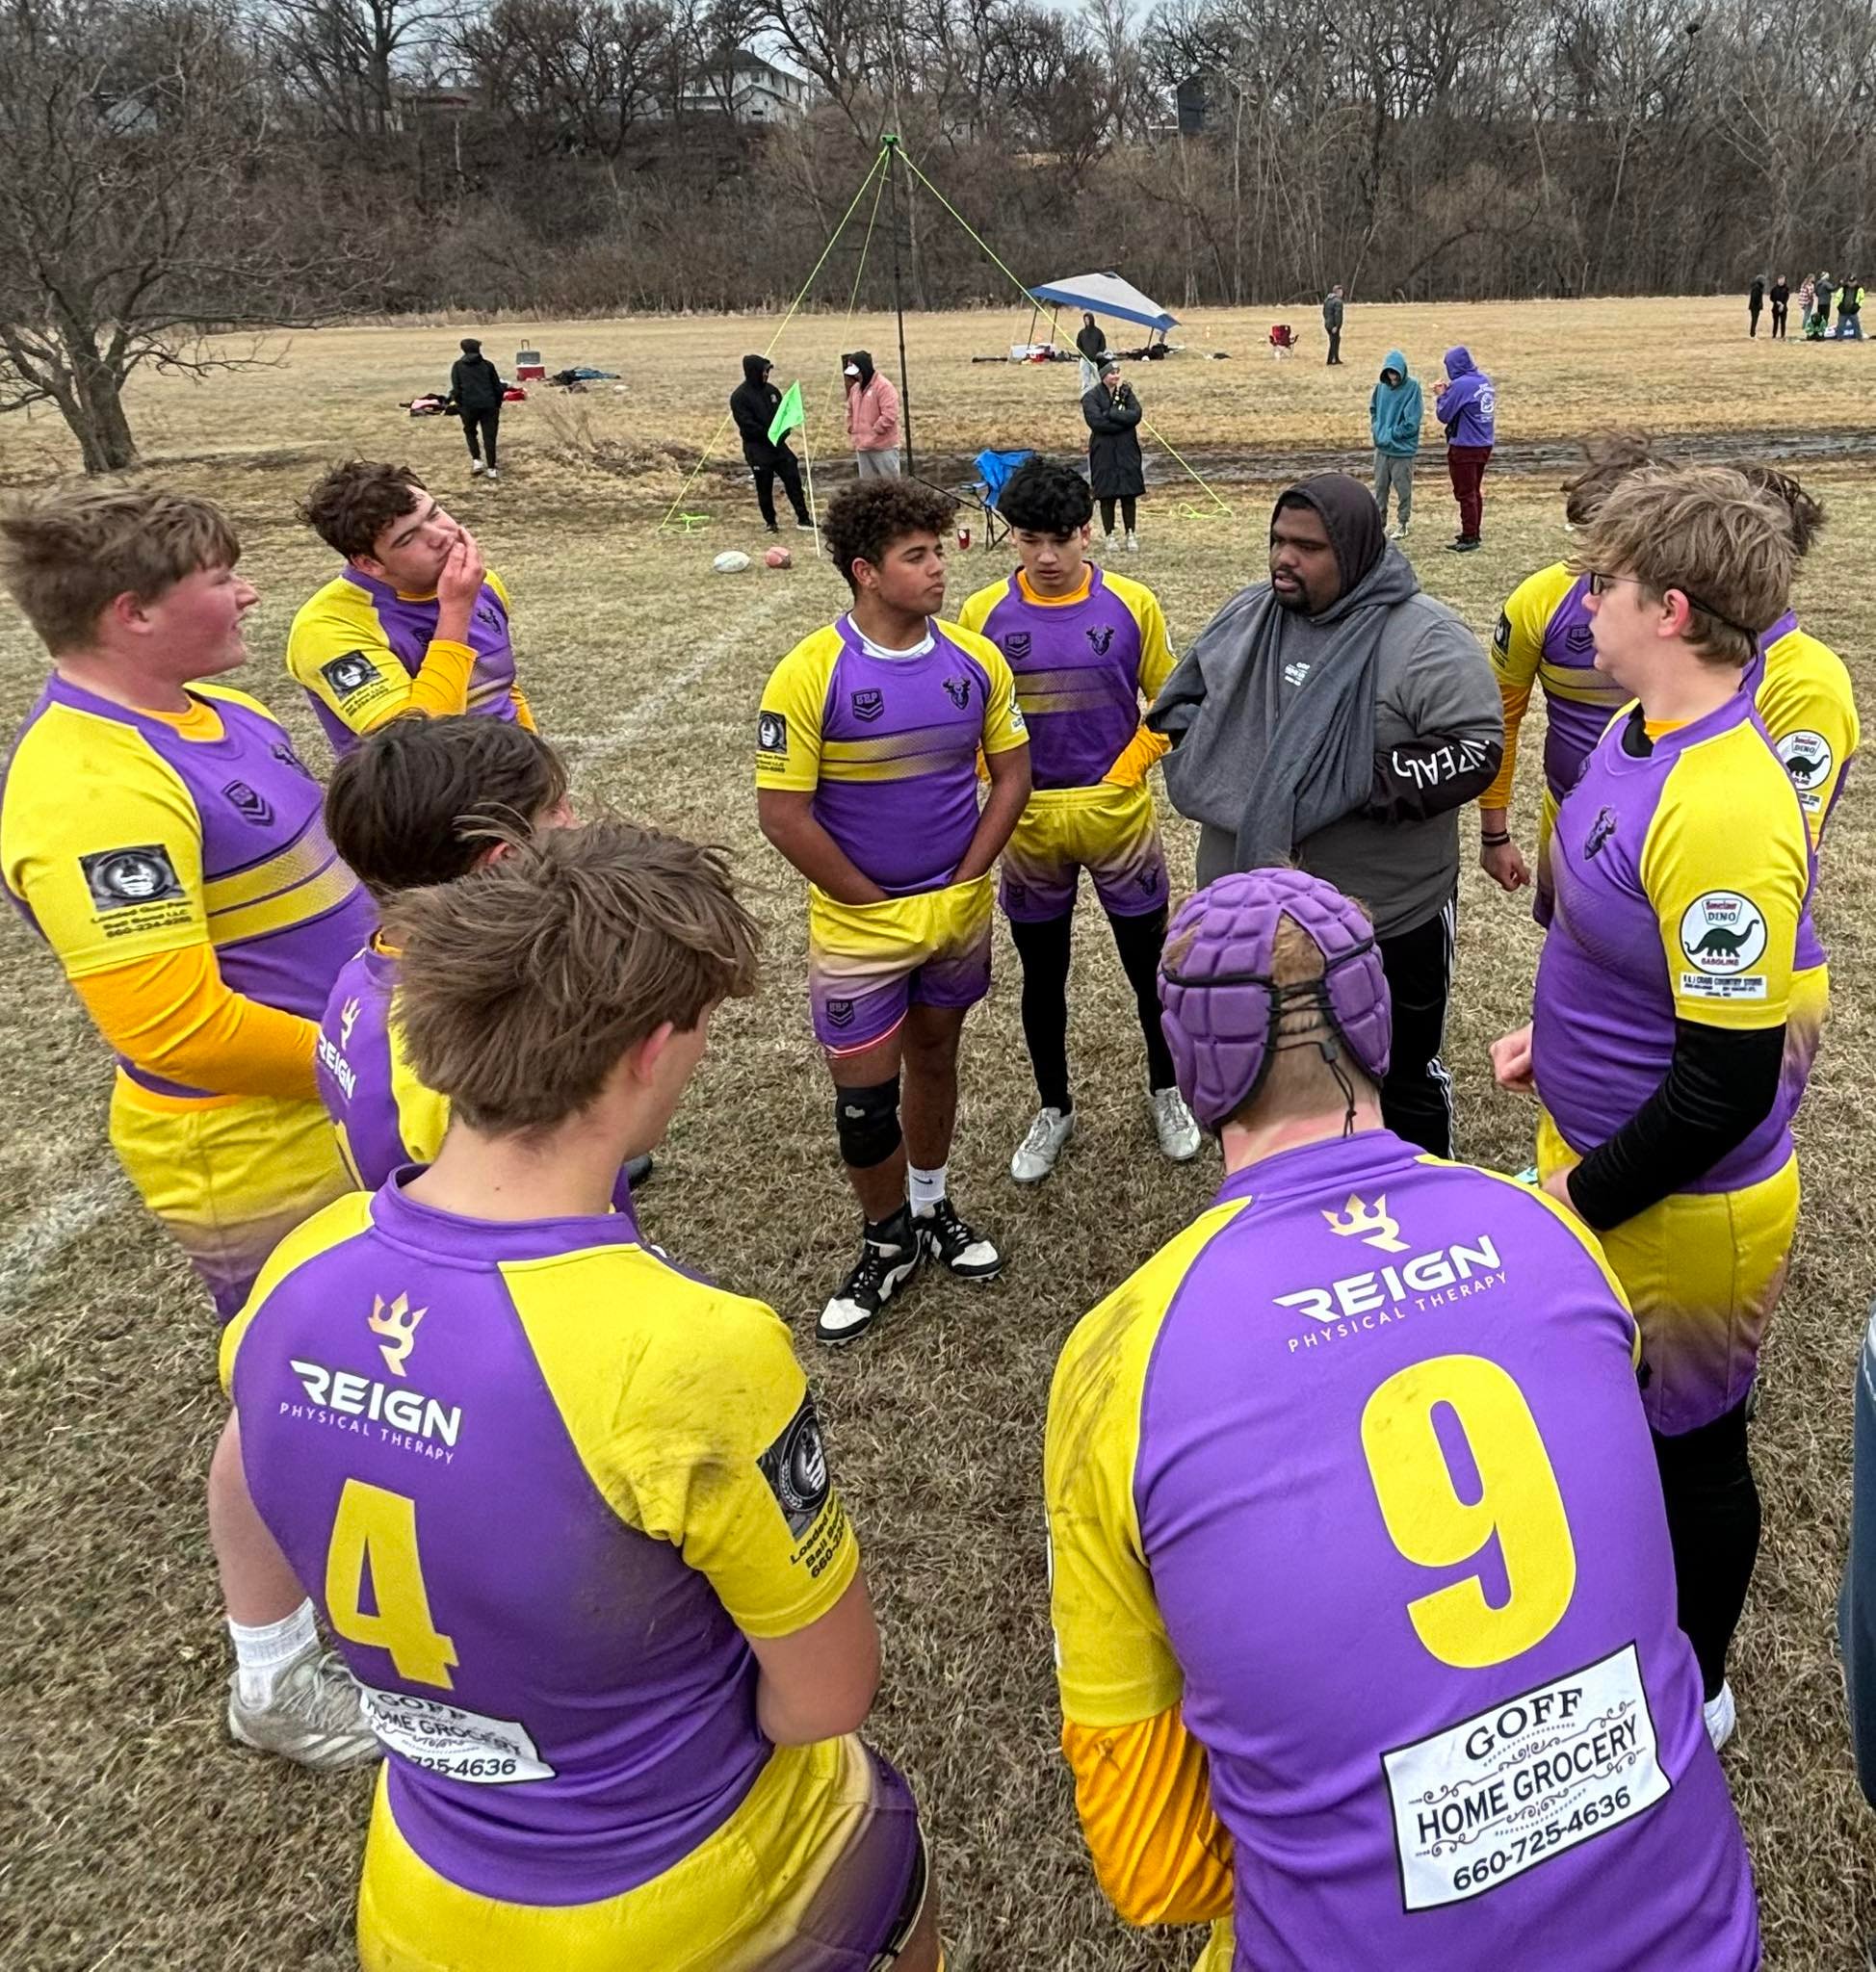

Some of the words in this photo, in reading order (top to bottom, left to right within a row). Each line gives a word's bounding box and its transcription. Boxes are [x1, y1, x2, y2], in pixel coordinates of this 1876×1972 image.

[1707, 912, 1736, 921] DINO
[319, 1030, 356, 1100] REIGN
[1272, 1234, 1501, 1324] REIGN
[1288, 1308, 1406, 1353] PHYSICAL
[1415, 1271, 1507, 1312] THERAPY
[279, 1402, 370, 1437] PHYSICAL
[380, 1429, 455, 1465] THERAPY
[290, 1360, 462, 1447] REIGN
[789, 1515, 829, 1566] Loaded
[1361, 1354, 1577, 1669] 9
[325, 1477, 459, 1691] 4
[1465, 1687, 1583, 1761] GOFF
[1417, 1779, 1509, 1845] HOME
[1513, 1713, 1637, 1802] GROCERY
[1453, 1785, 1632, 1891] 660-725-4636
